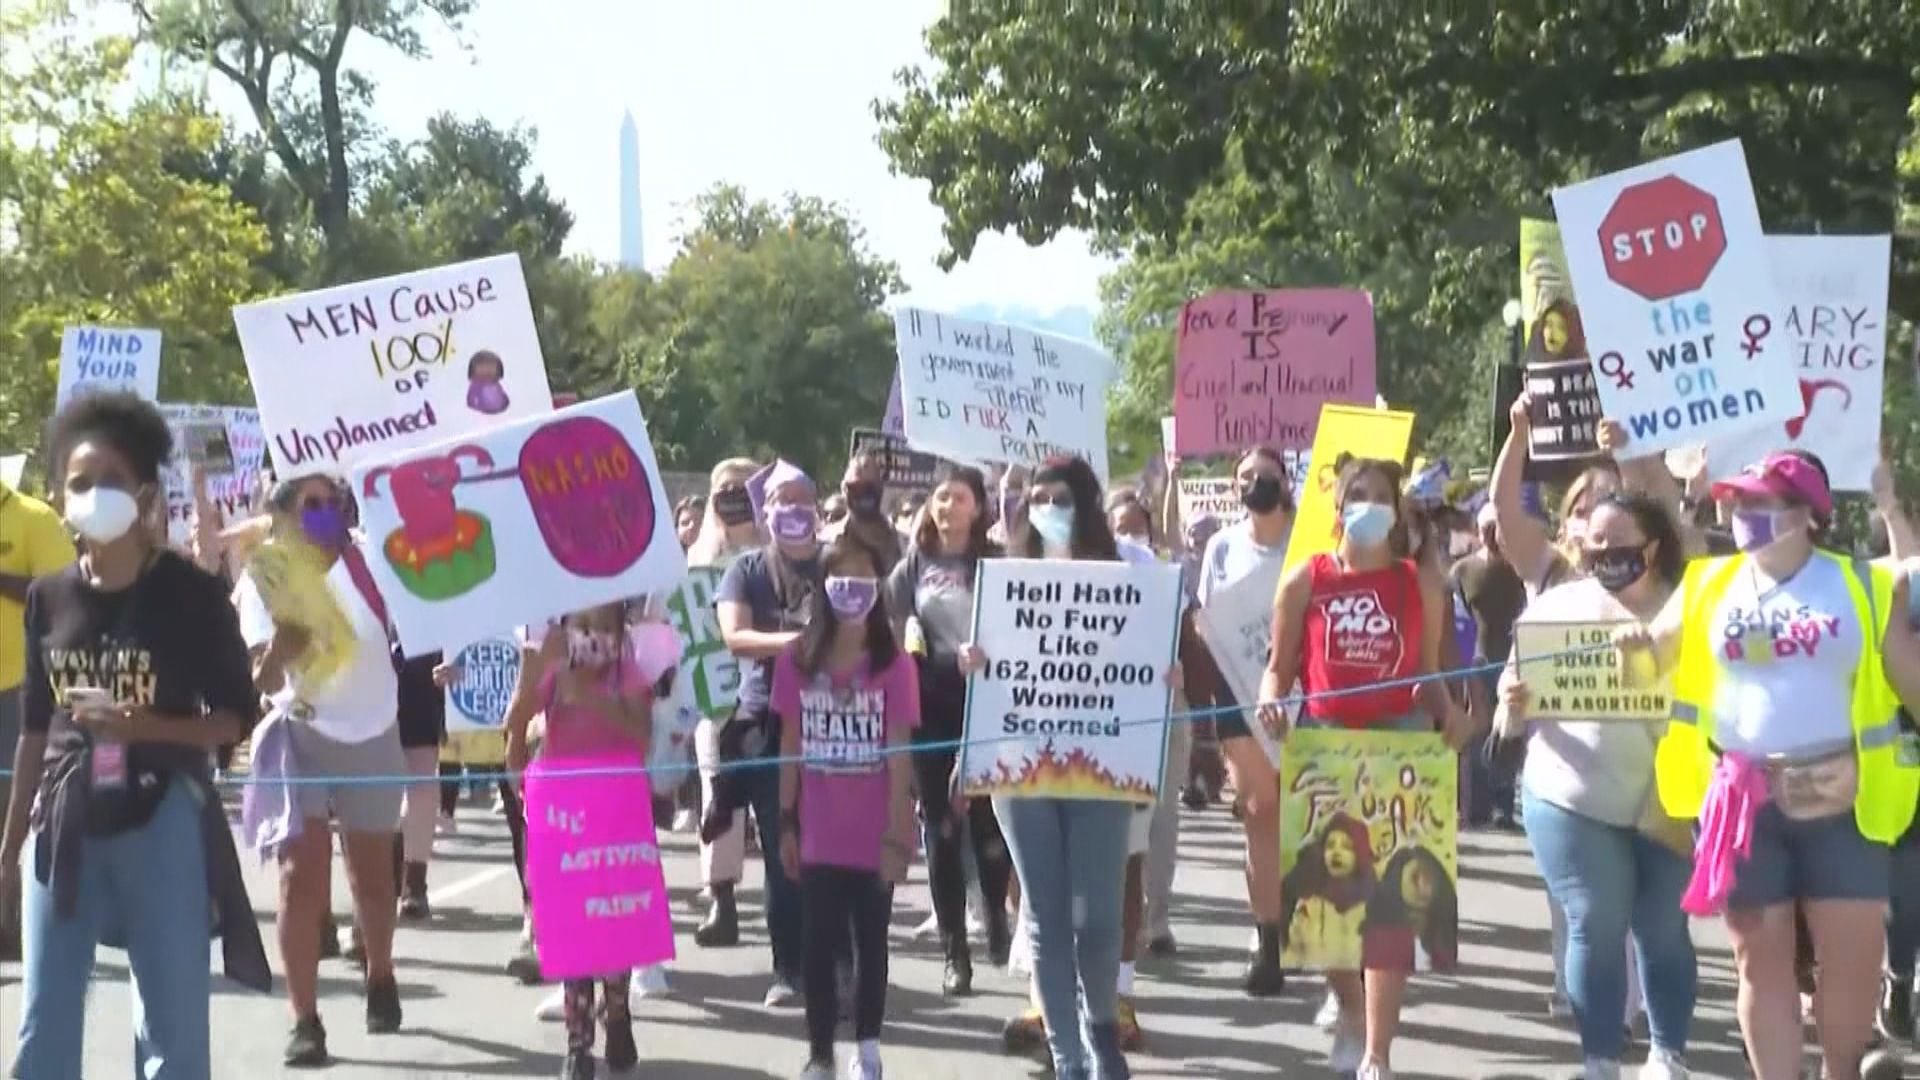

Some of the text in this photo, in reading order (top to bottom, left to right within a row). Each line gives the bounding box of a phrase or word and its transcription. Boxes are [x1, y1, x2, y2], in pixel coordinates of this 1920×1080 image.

[1612, 211, 1709, 262] STOP
[285, 276, 498, 344] MEN Cause
[1651, 299, 1712, 336] the
[77, 329, 142, 355] MIND
[370, 319, 457, 379] 100%
[1241, 329, 1285, 361] IS
[1646, 332, 1716, 374] war
[78, 355, 137, 379] YOUR
[396, 371, 430, 393] OF
[1675, 367, 1718, 397] on
[962, 403, 1013, 433] FUCK
[1026, 417, 1039, 437] A
[1629, 388, 1766, 440] women
[276, 402, 437, 466] Unplanned
[1006, 580, 1142, 605] Hell Hath
[1328, 596, 1376, 616] NO
[1015, 607, 1127, 635] No Fury
[1333, 613, 1392, 635] MO
[465, 642, 514, 663] KEEP
[1039, 634, 1099, 656] Like
[1724, 638, 1819, 662] BDY
[1552, 653, 1617, 669] SOMEO
[1554, 675, 1598, 691] WHO
[459, 684, 512, 714] LEGA
[1012, 686, 1115, 710] Women
[1538, 693, 1666, 713] AN ABORTION
[801, 711, 883, 740] HEALTH
[1002, 712, 1121, 737] Scorned
